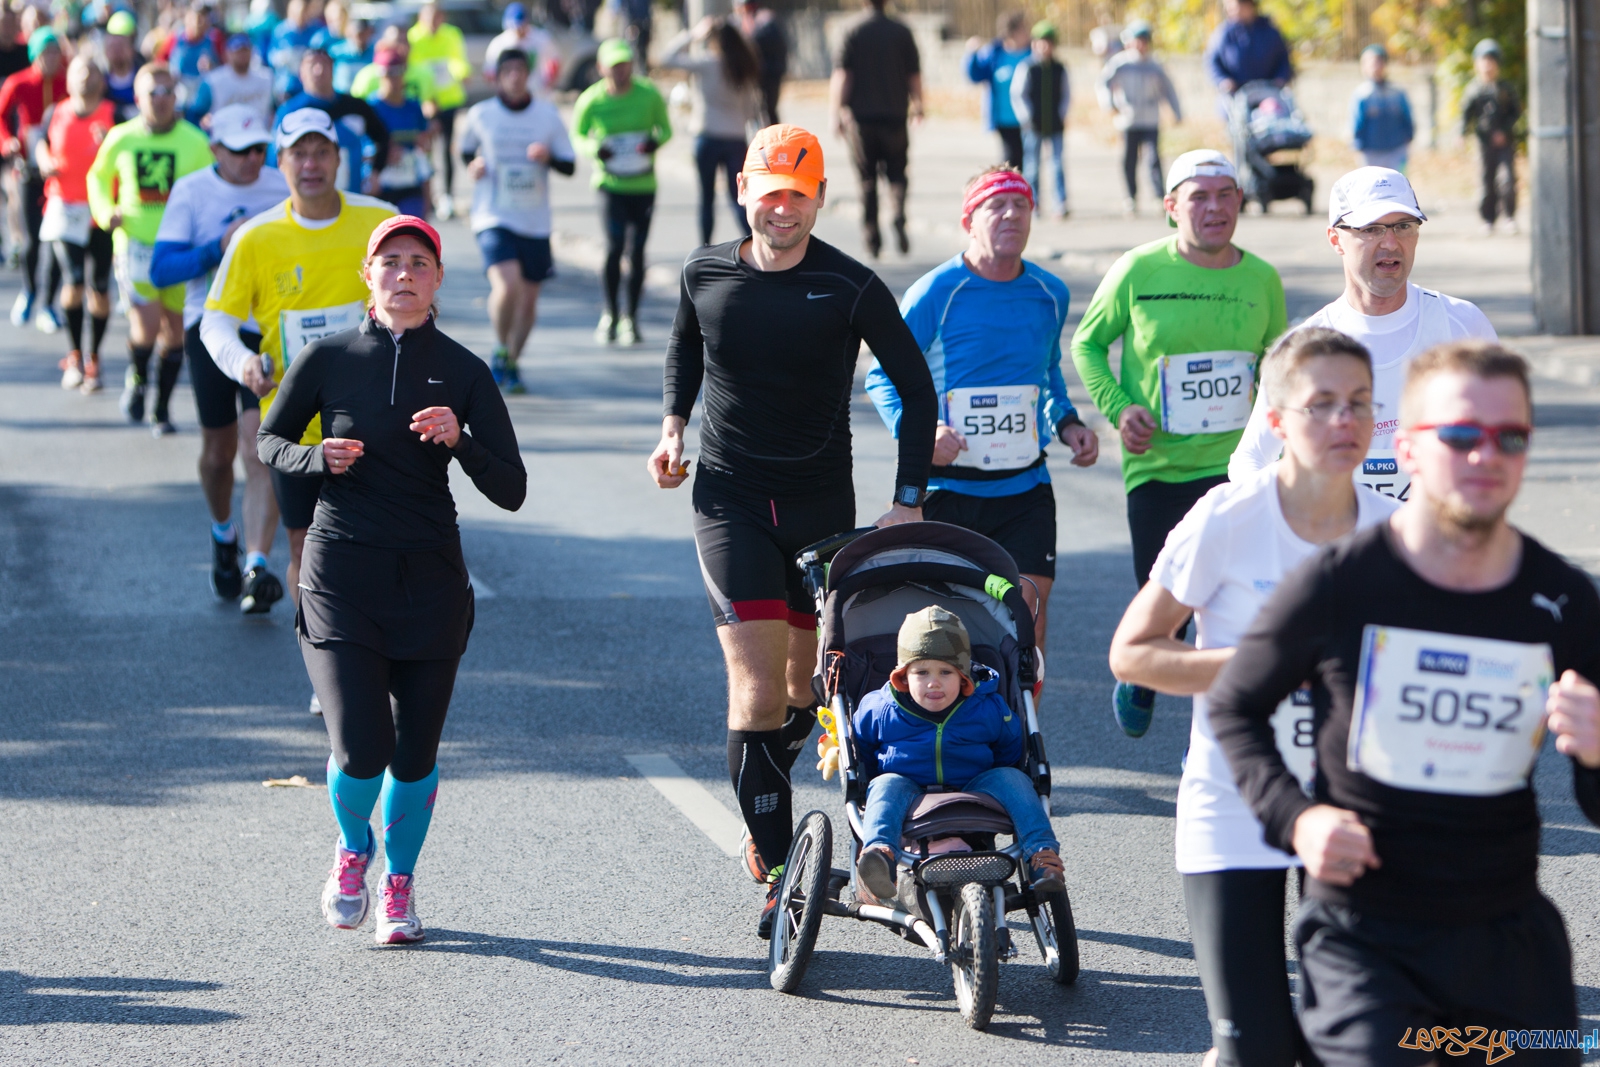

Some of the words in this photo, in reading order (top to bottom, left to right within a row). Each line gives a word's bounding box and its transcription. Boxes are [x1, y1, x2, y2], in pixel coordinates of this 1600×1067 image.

[1181, 375, 1242, 400] 5002
[964, 413, 1026, 435] 5343
[1397, 685, 1524, 733] 5052
[754, 805, 777, 814] cep
